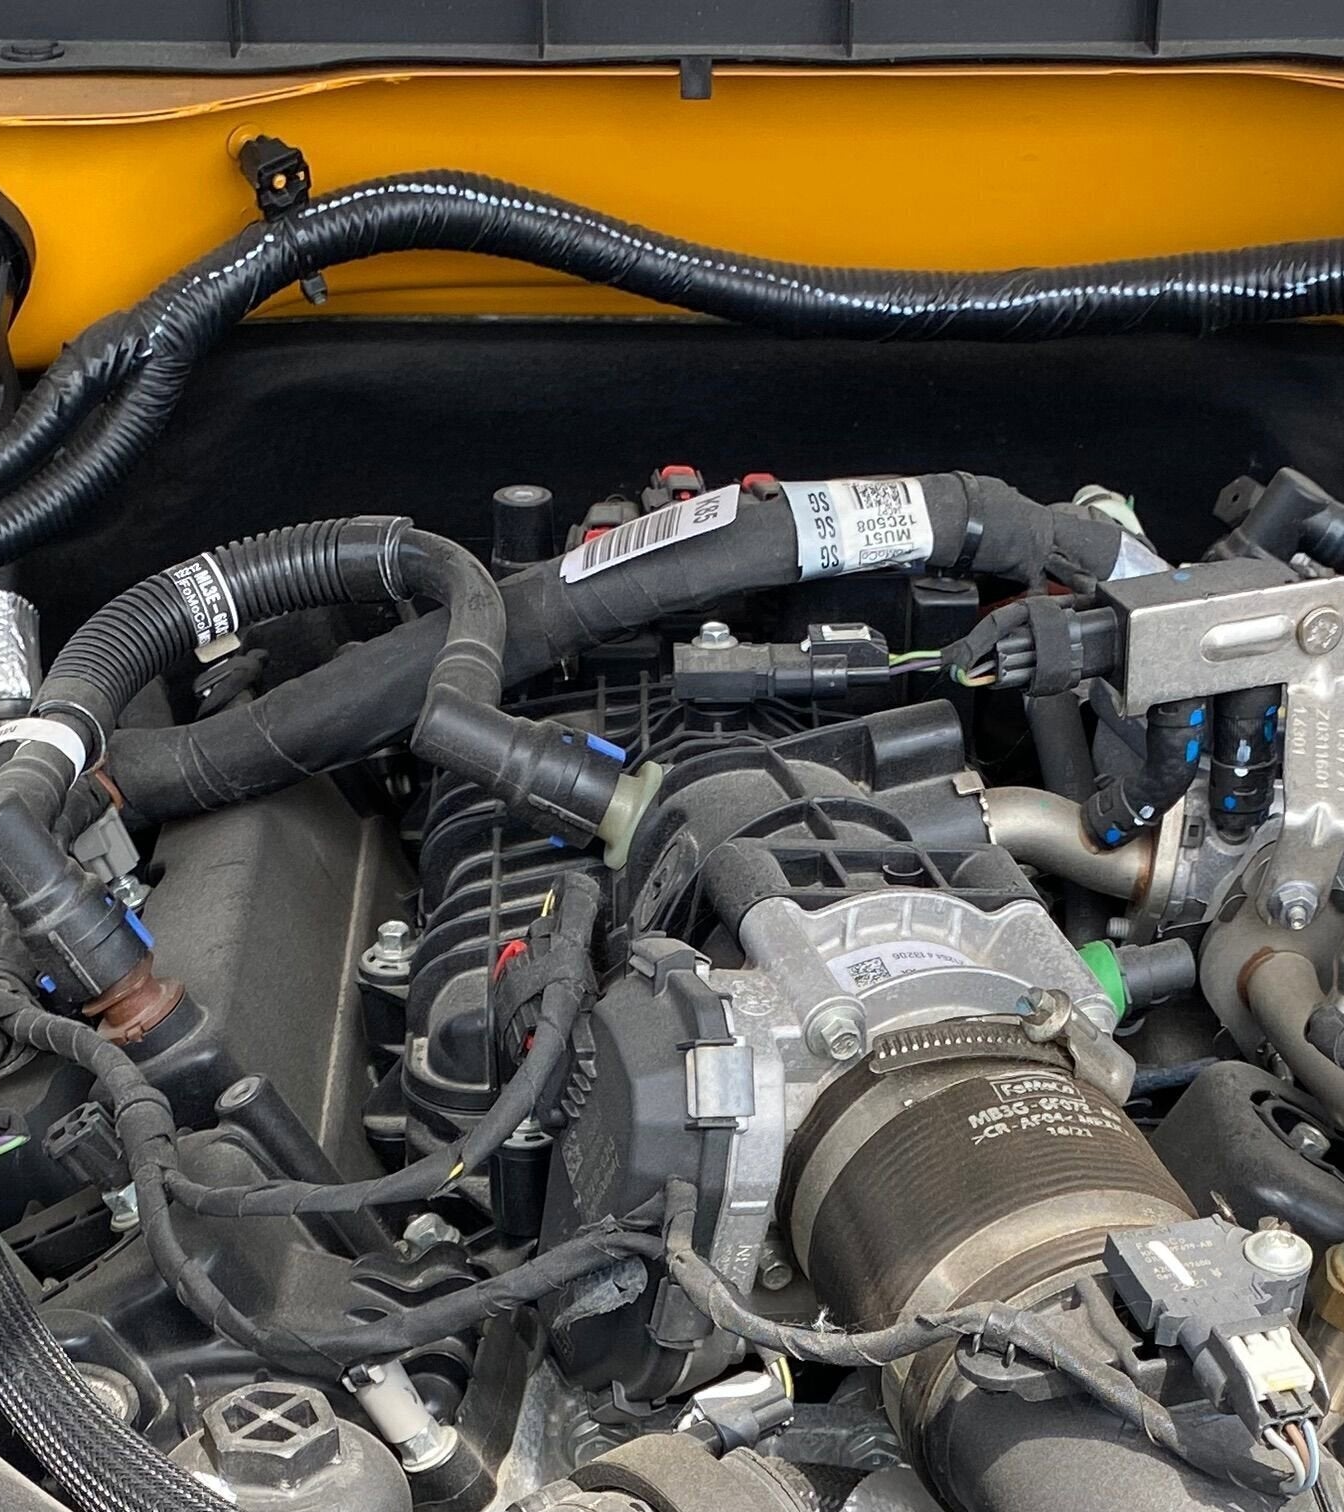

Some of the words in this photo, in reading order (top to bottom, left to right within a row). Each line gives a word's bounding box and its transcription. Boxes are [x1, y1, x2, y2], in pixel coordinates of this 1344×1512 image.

[692, 494, 721, 524] K85
[807, 491, 830, 513] SG
[814, 515, 837, 540] SG
[856, 513, 917, 534] 12C508
[863, 527, 912, 547] MU5T
[820, 544, 840, 569] SG
[178, 579, 206, 629] FoMoCo
